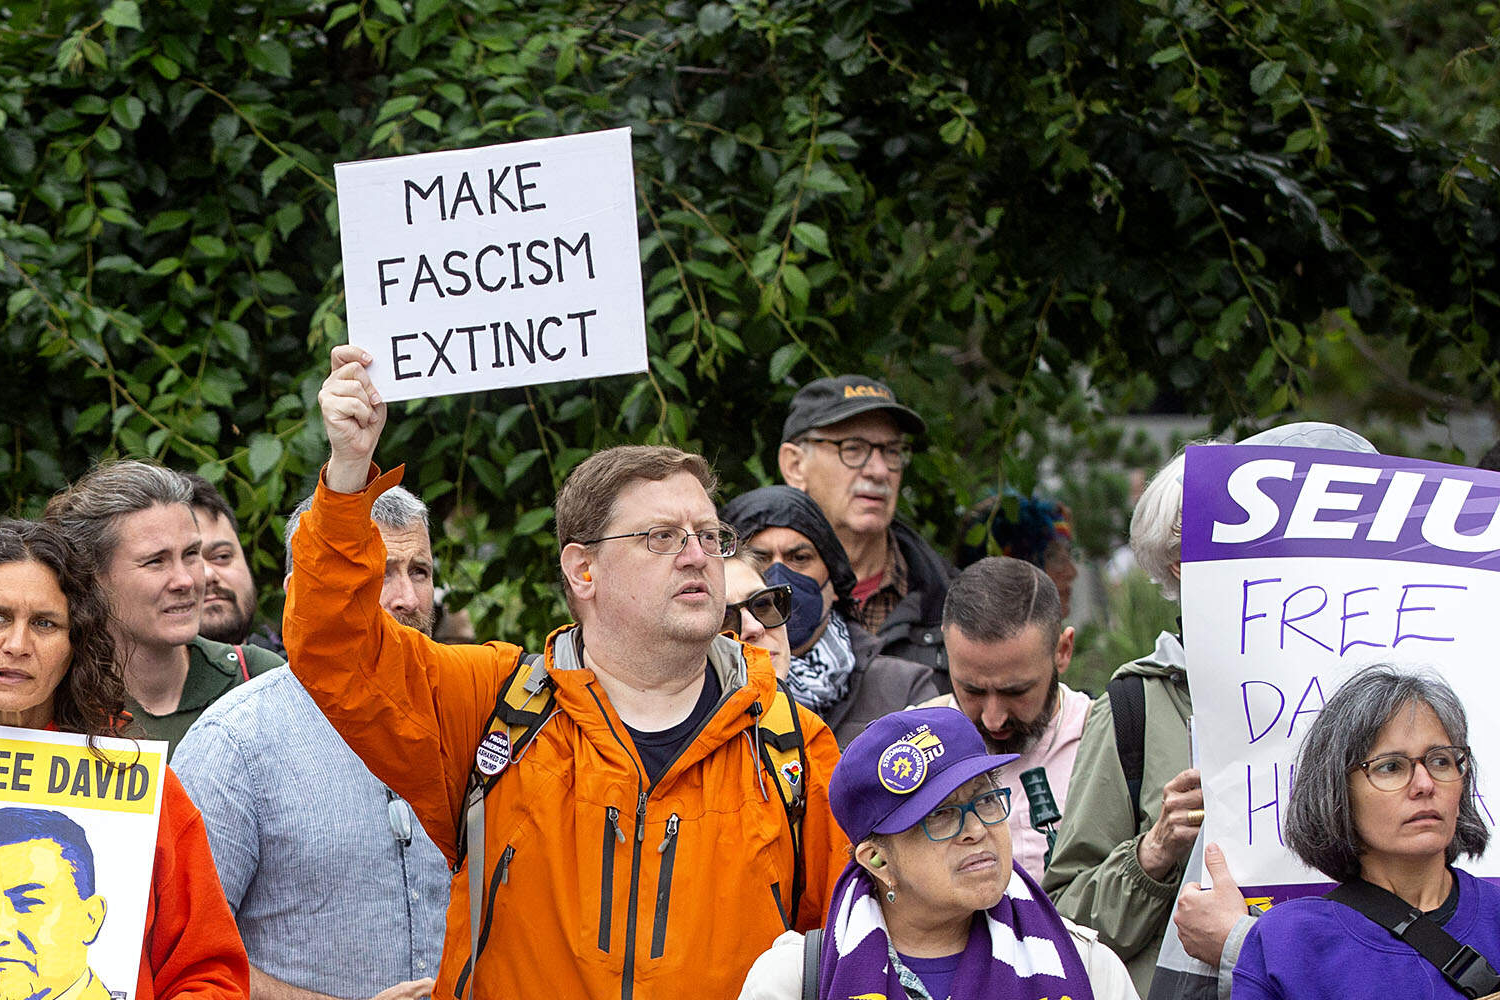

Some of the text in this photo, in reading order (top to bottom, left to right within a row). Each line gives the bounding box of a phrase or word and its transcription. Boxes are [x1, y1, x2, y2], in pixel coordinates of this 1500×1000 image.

[404, 162, 546, 225] MAKE
[377, 232, 595, 306] FASCISM
[391, 309, 597, 380] EXTINCT
[1211, 459, 1500, 553] SEIU
[1240, 577, 1468, 657] FREE
[48, 756, 150, 803] DAVID
[882, 746, 923, 782] STRONGER TOGETHER
